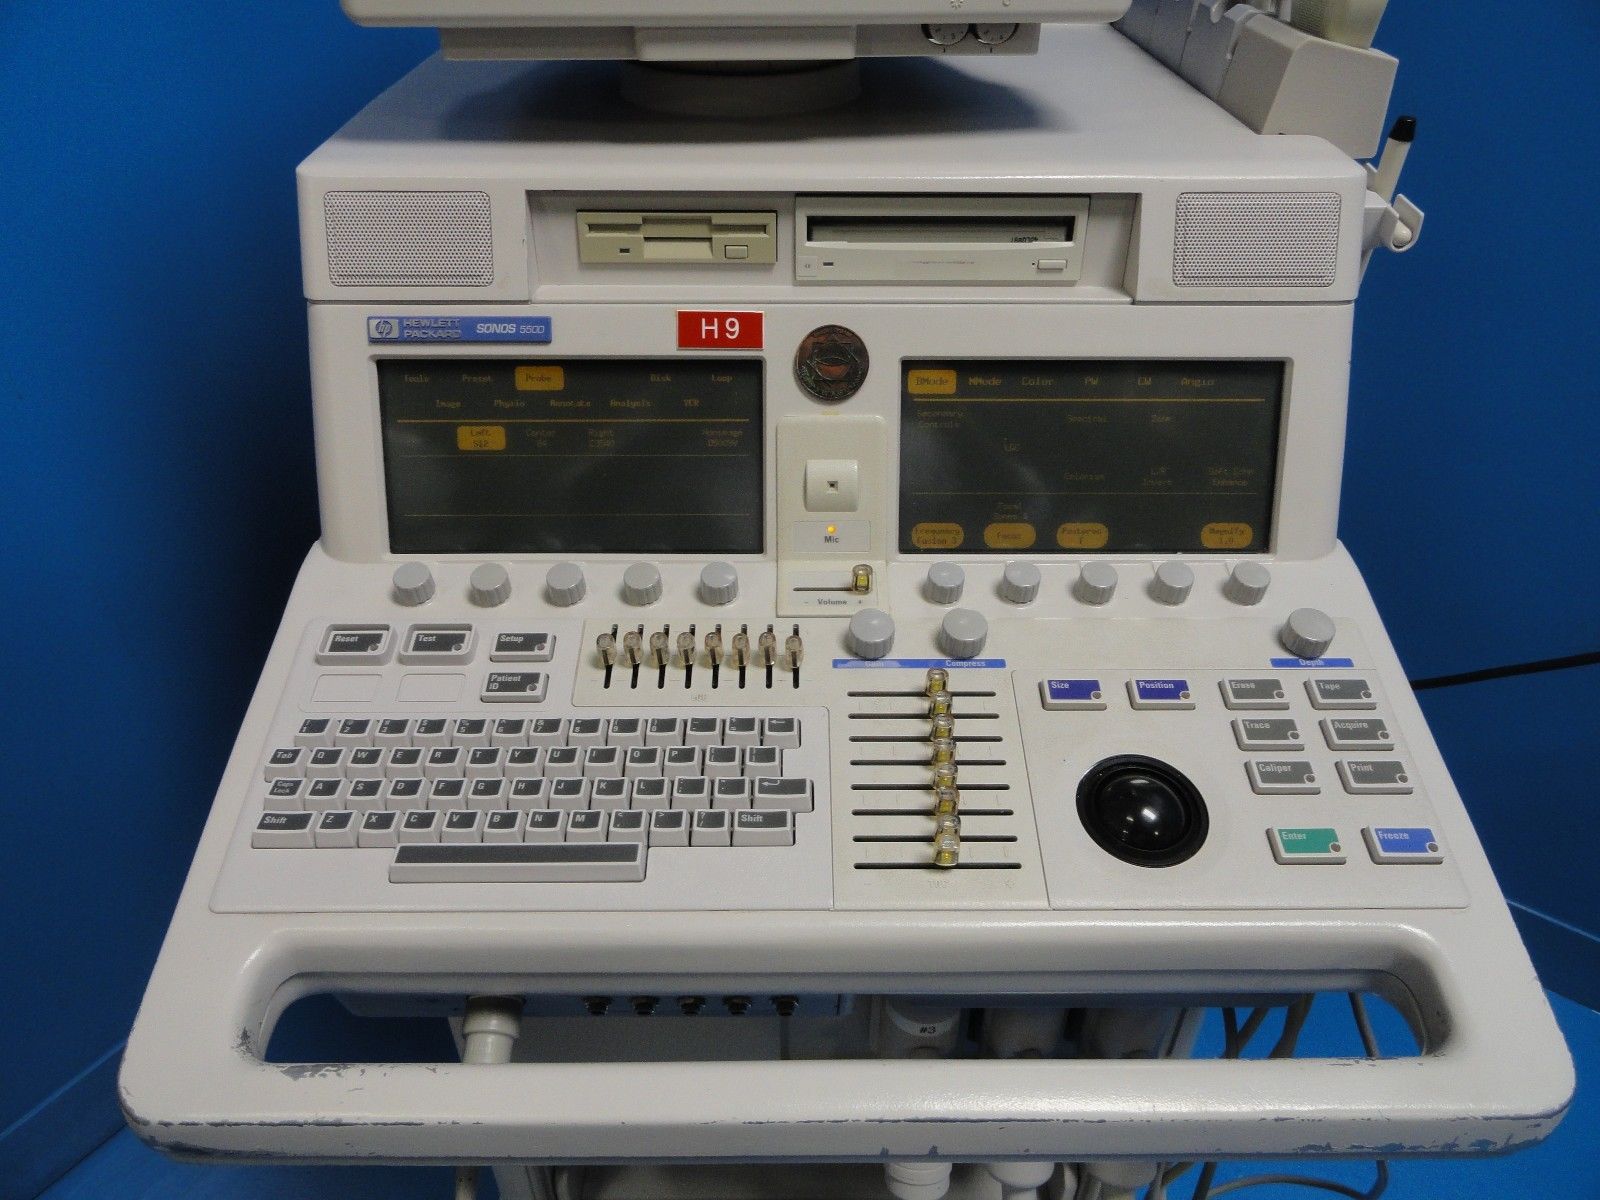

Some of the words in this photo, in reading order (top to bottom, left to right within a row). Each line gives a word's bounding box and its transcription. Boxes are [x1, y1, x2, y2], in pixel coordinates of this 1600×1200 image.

[402, 318, 461, 328] HEWLETT
[476, 323, 517, 335] SONOS
[519, 325, 545, 335] 5500
[402, 329, 462, 339] PACKARD
[824, 535, 840, 544] Mic
[816, 598, 848, 606] Volume
[334, 634, 359, 643] Reset
[418, 634, 437, 643] Test
[500, 634, 524, 644] Setup
[945, 660, 986, 669] Compress
[490, 673, 522, 683] Patient
[1051, 681, 1070, 690] Size
[1139, 681, 1175, 690] Position
[1231, 681, 1256, 690] Erase
[1319, 682, 1342, 692] Tape
[1244, 720, 1271, 729] Trace
[1333, 720, 1370, 731] Acquire
[276, 751, 294, 759] Tab
[357, 751, 369, 759] W
[435, 751, 442, 759] R
[515, 750, 522, 758] Y
[553, 750, 560, 758] U
[671, 750, 679, 758] P
[1258, 763, 1292, 773] Caliper
[1350, 763, 1374, 773] Print
[315, 782, 323, 790] A
[438, 782, 445, 790] F
[477, 782, 486, 790] G
[518, 782, 526, 790] H
[557, 782, 565, 790] J
[599, 781, 607, 789] K
[640, 781, 647, 789] L
[263, 815, 288, 825] Shift
[326, 815, 335, 823] Z
[368, 815, 378, 823] X
[410, 814, 418, 822] C
[451, 814, 460, 822] V
[493, 814, 501, 823] B
[534, 814, 543, 823] N
[574, 814, 586, 823] M
[740, 814, 764, 823] Shift
[1281, 831, 1308, 840] Enter
[1378, 831, 1410, 840] Freeze
